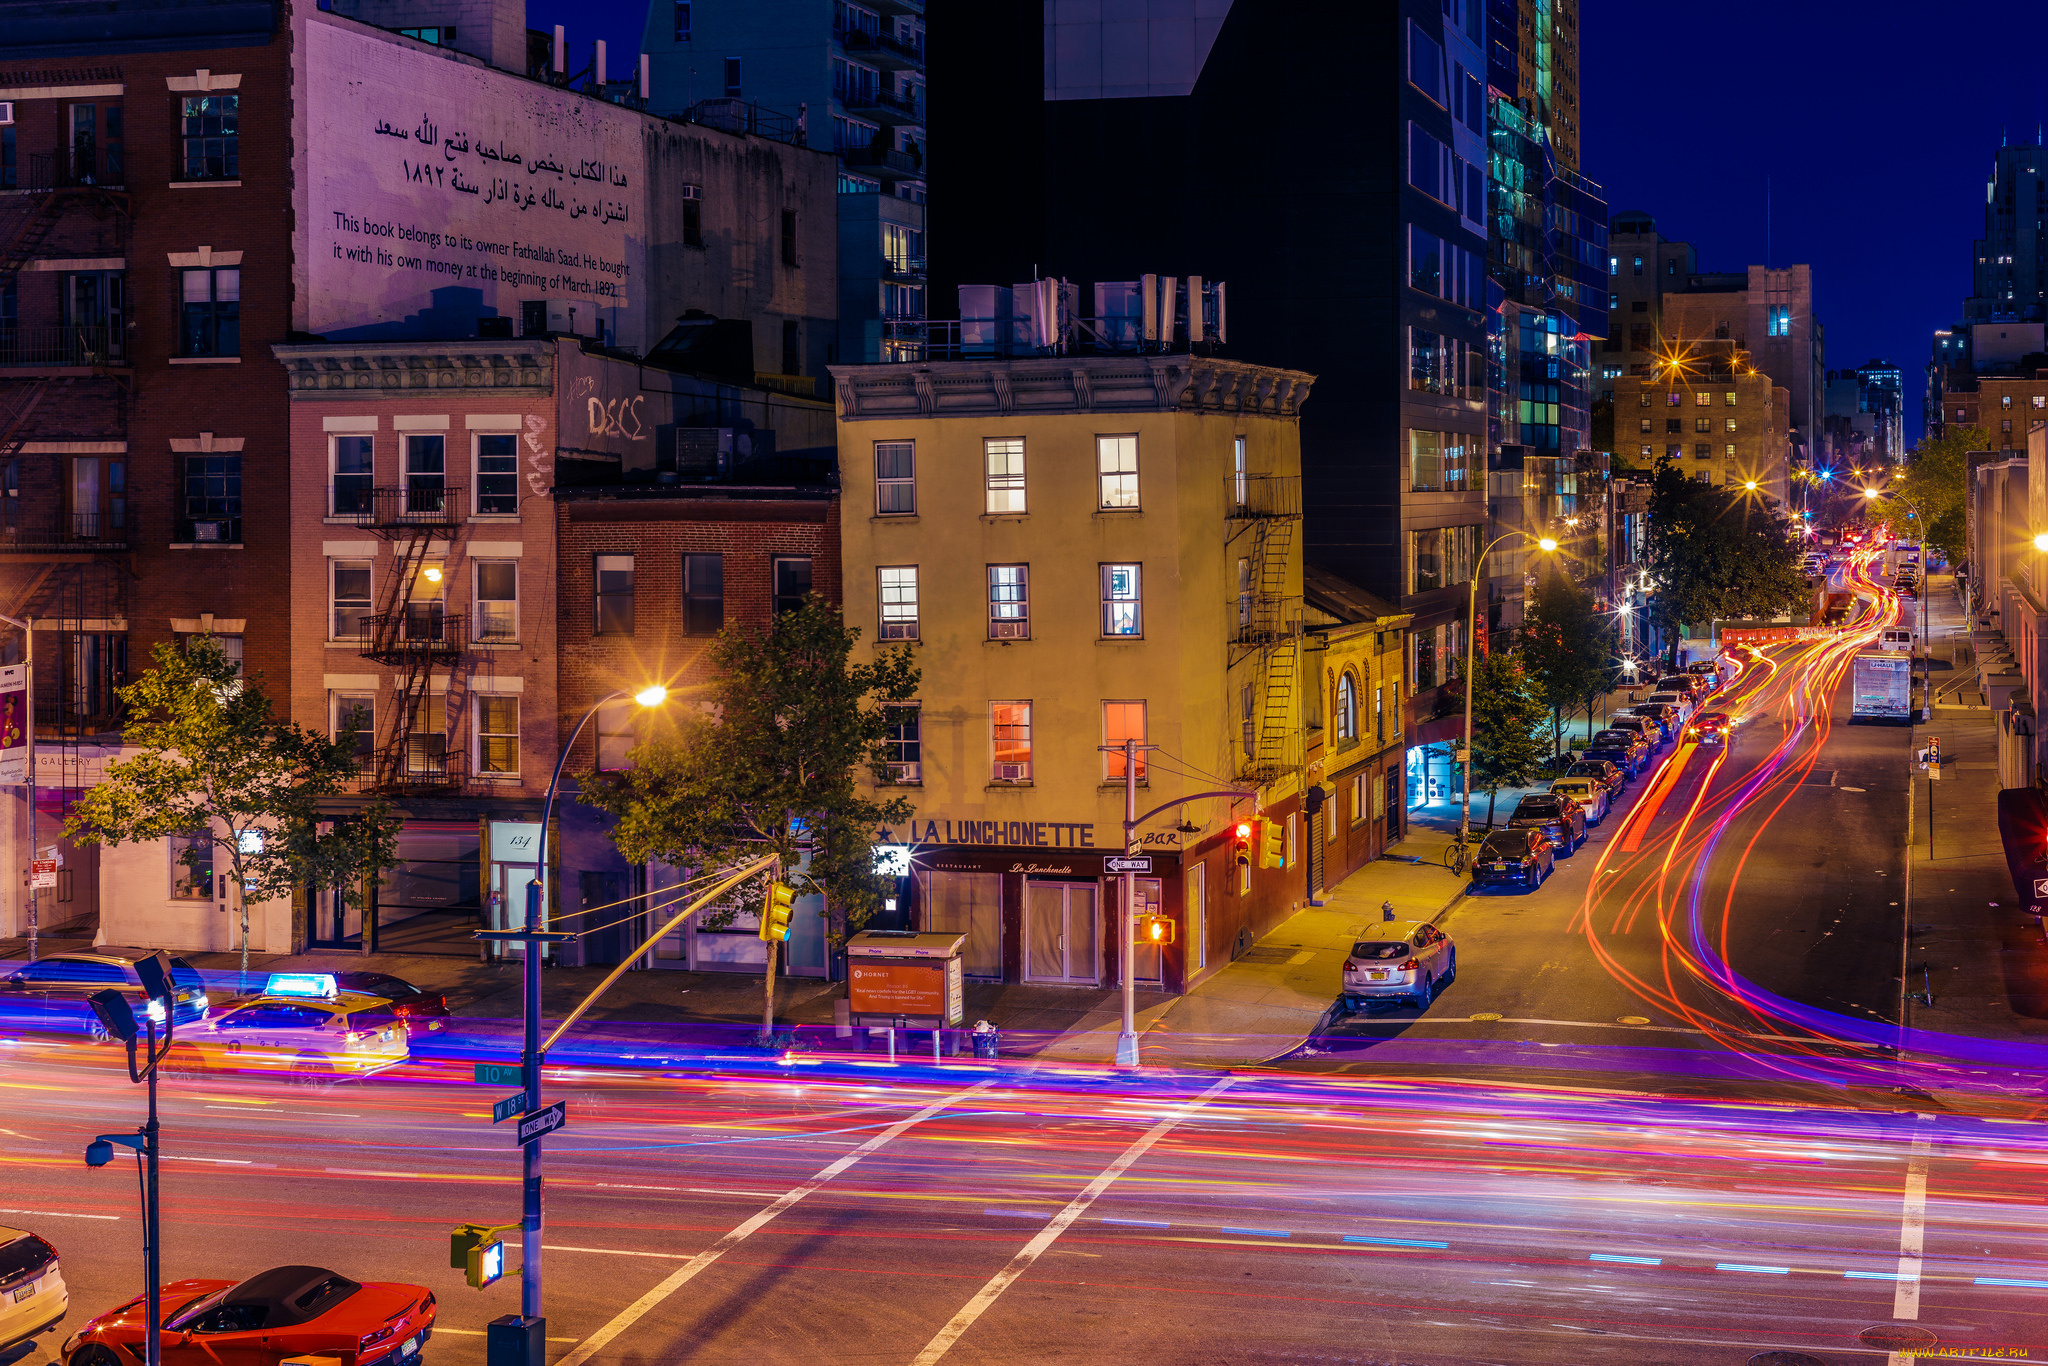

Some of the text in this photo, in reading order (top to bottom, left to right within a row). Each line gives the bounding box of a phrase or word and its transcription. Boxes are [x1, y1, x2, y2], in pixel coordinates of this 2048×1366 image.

[375, 113, 627, 187] هذا الكتاب يخص صاحبه فتح الله سعد
[404, 160, 444, 188] ١٨٩٢
[451, 168, 478, 195] سنة
[514, 184, 536, 210] غرة
[542, 188, 564, 210] ماله
[570, 198, 587, 218] من
[593, 200, 628, 224] اشتراه
[333, 211, 630, 278] This book belongs to its owner Fathallah Saad. He bought
[333, 242, 618, 298] it with his own money at the beginning of March 1892.
[41, 757, 91, 766] GALLERY
[510, 836, 532, 847] 134
[912, 820, 1094, 847] LA LUNCHONETTE
[1143, 833, 1181, 845] BAR
[1009, 863, 1024, 873] La
[485, 1066, 512, 1082] 10 AV
[496, 1094, 524, 1120] W 18 ST
[525, 1112, 558, 1134] ONE WAY
